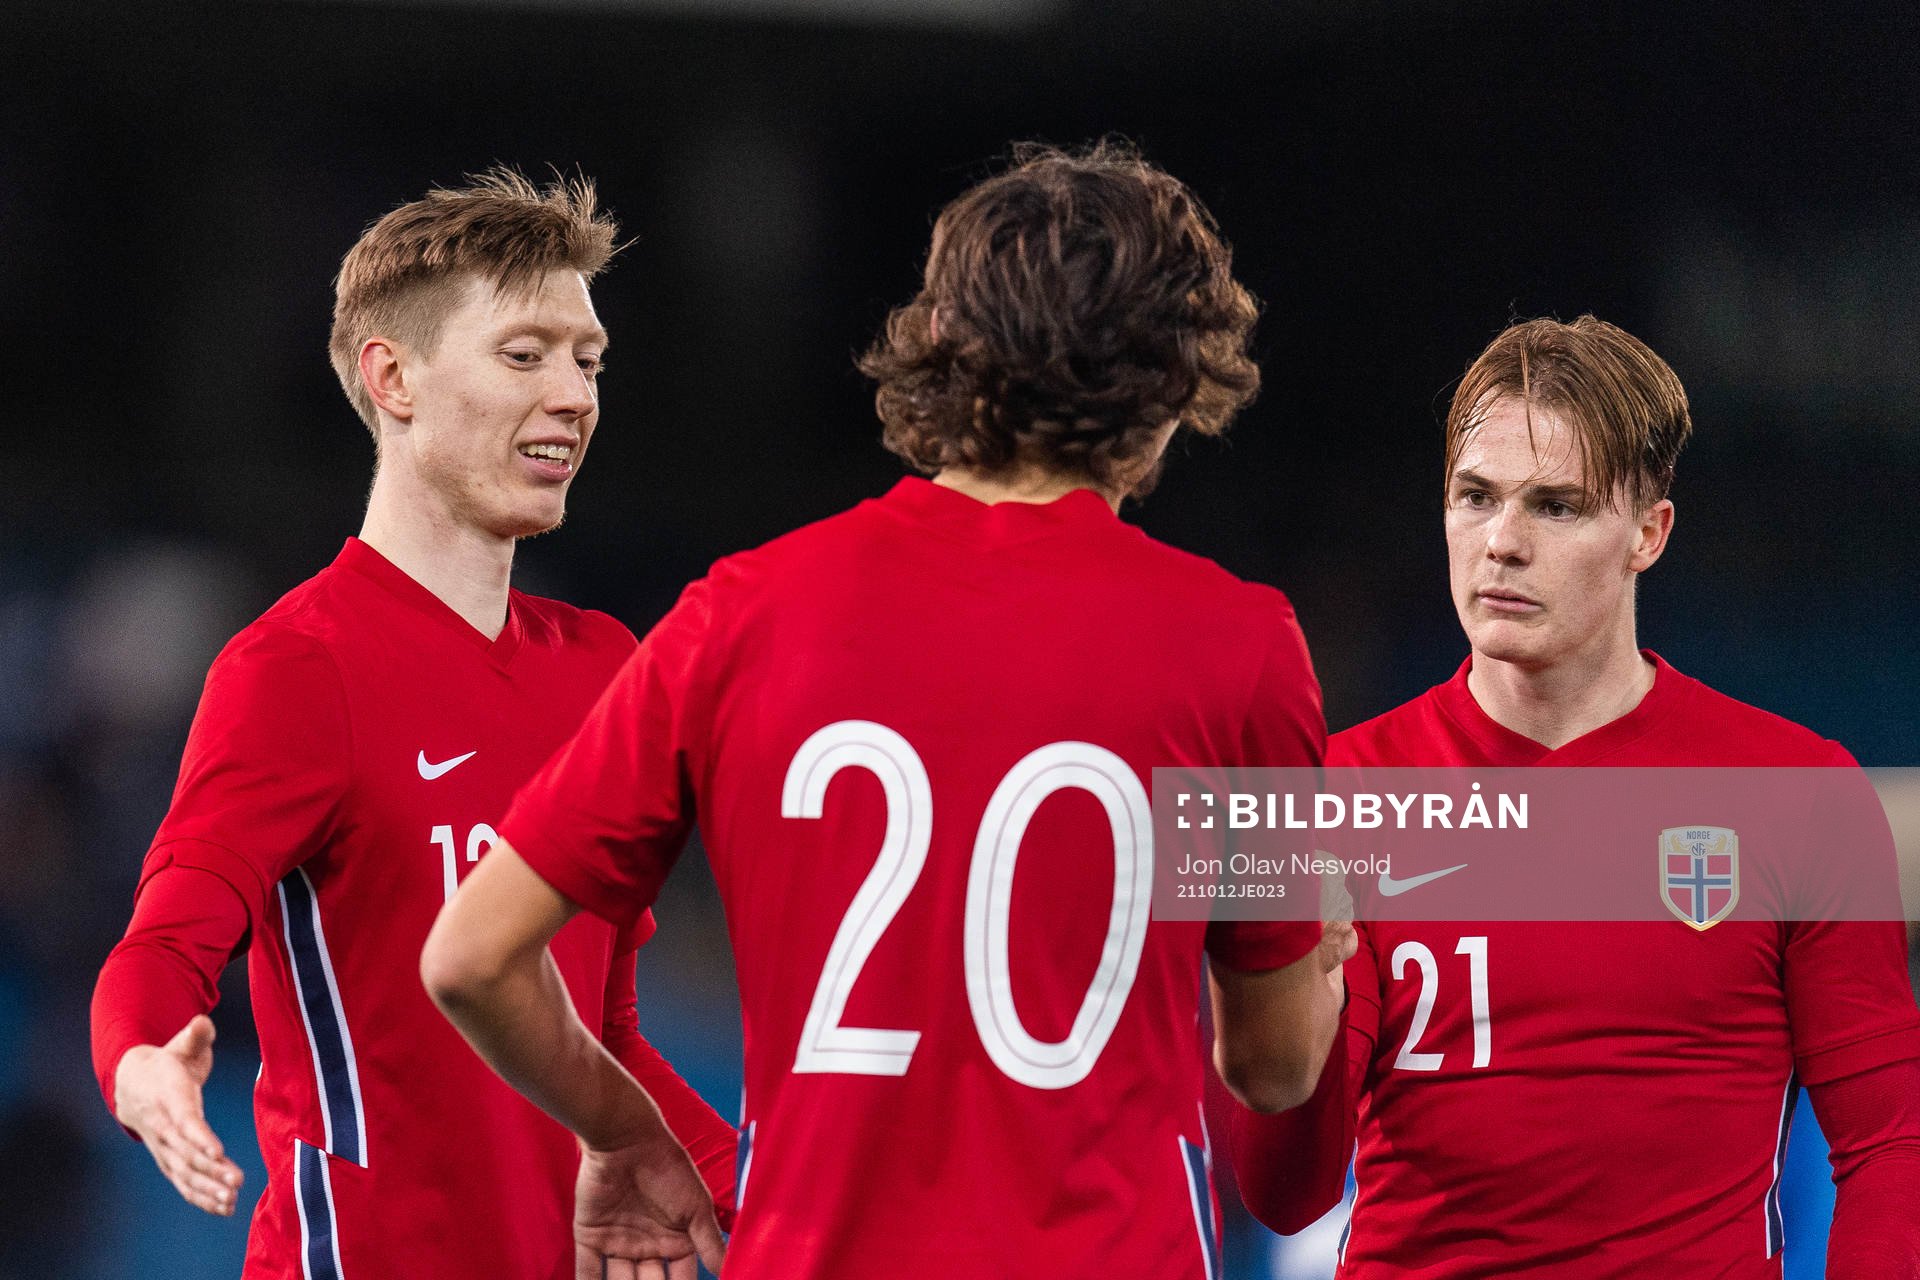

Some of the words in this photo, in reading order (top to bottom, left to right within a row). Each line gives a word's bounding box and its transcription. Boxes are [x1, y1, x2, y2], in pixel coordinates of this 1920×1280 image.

[1686, 830, 1711, 840] NORGE
[781, 719, 1155, 1090] 20
[1391, 936, 1492, 1071] 21
